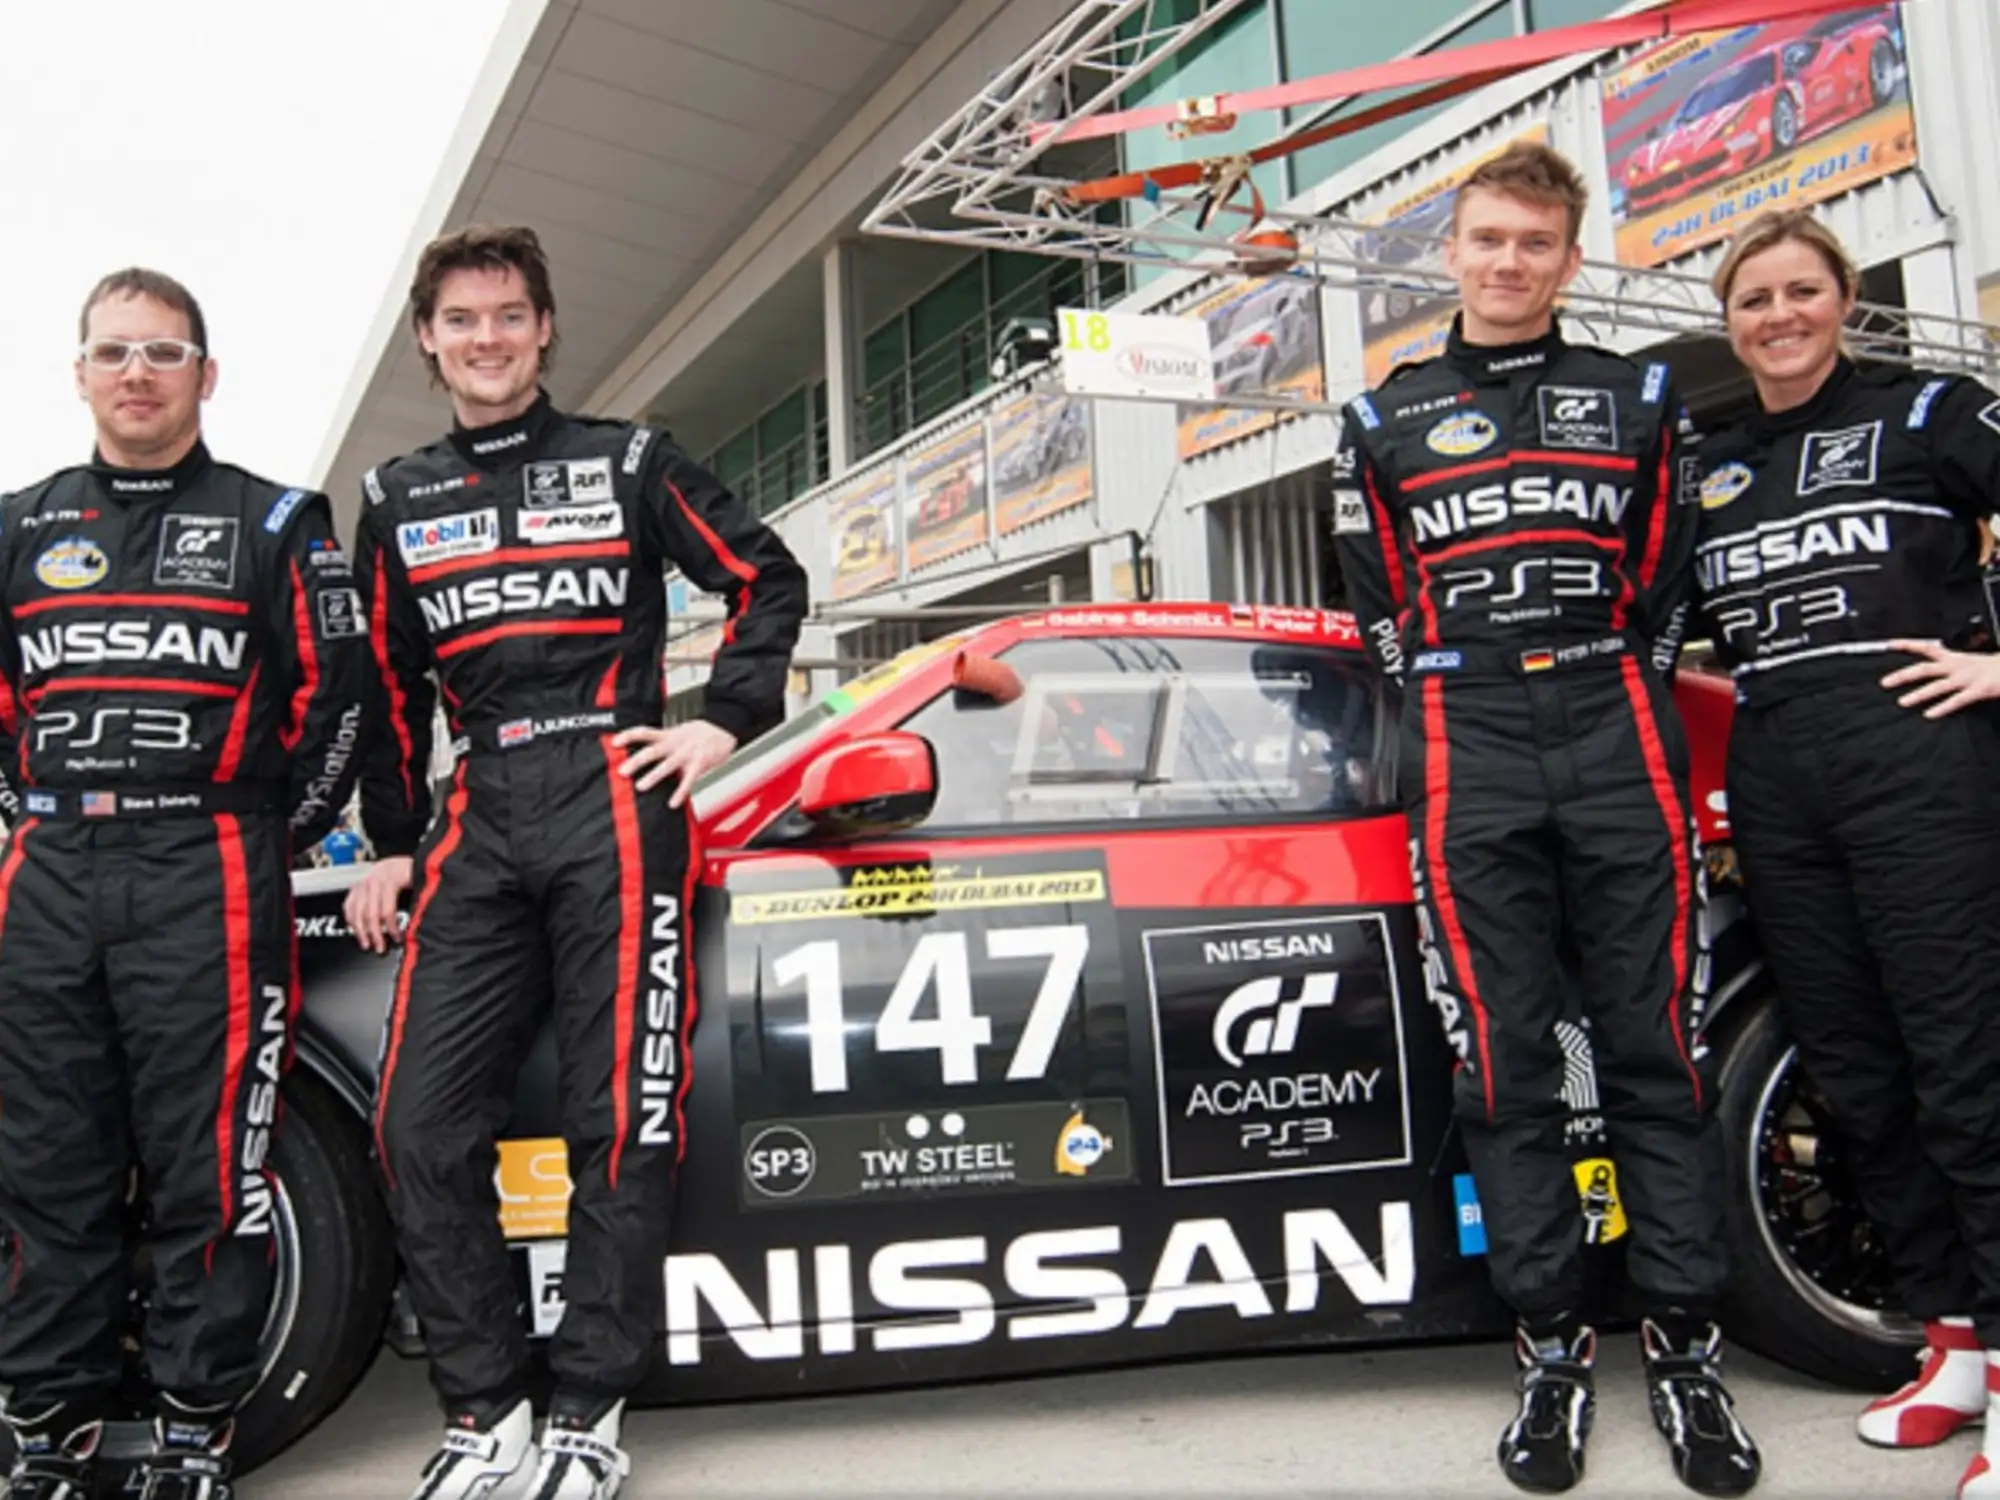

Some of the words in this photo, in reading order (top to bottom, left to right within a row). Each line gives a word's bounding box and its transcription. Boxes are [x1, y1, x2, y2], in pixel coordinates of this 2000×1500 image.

[1709, 177, 1790, 224] DUBAI
[1798, 144, 1869, 188] 2013
[1064, 314, 1111, 352] 18
[405, 520, 464, 548] Mobil
[546, 511, 616, 528] AVON
[1410, 476, 1633, 543] NISSAN
[1696, 515, 1889, 590] NISSAN
[418, 568, 629, 633] NISSAN
[19, 622, 247, 674] NISSAN
[765, 891, 901, 916] DUNLOP
[957, 882, 1034, 902] DUBAI
[1037, 878, 1097, 896] 2013
[1204, 933, 1335, 964] NISSAN
[638, 894, 679, 1145] NISSAN
[773, 923, 1090, 1092] 147
[234, 985, 285, 1236] NISSAN
[1185, 1068, 1382, 1117] ACADEMY
[750, 1150, 810, 1177] SP3
[860, 1151, 908, 1175] TW
[916, 1143, 1013, 1173] STEEL
[664, 1201, 1417, 1365] NISSAN
